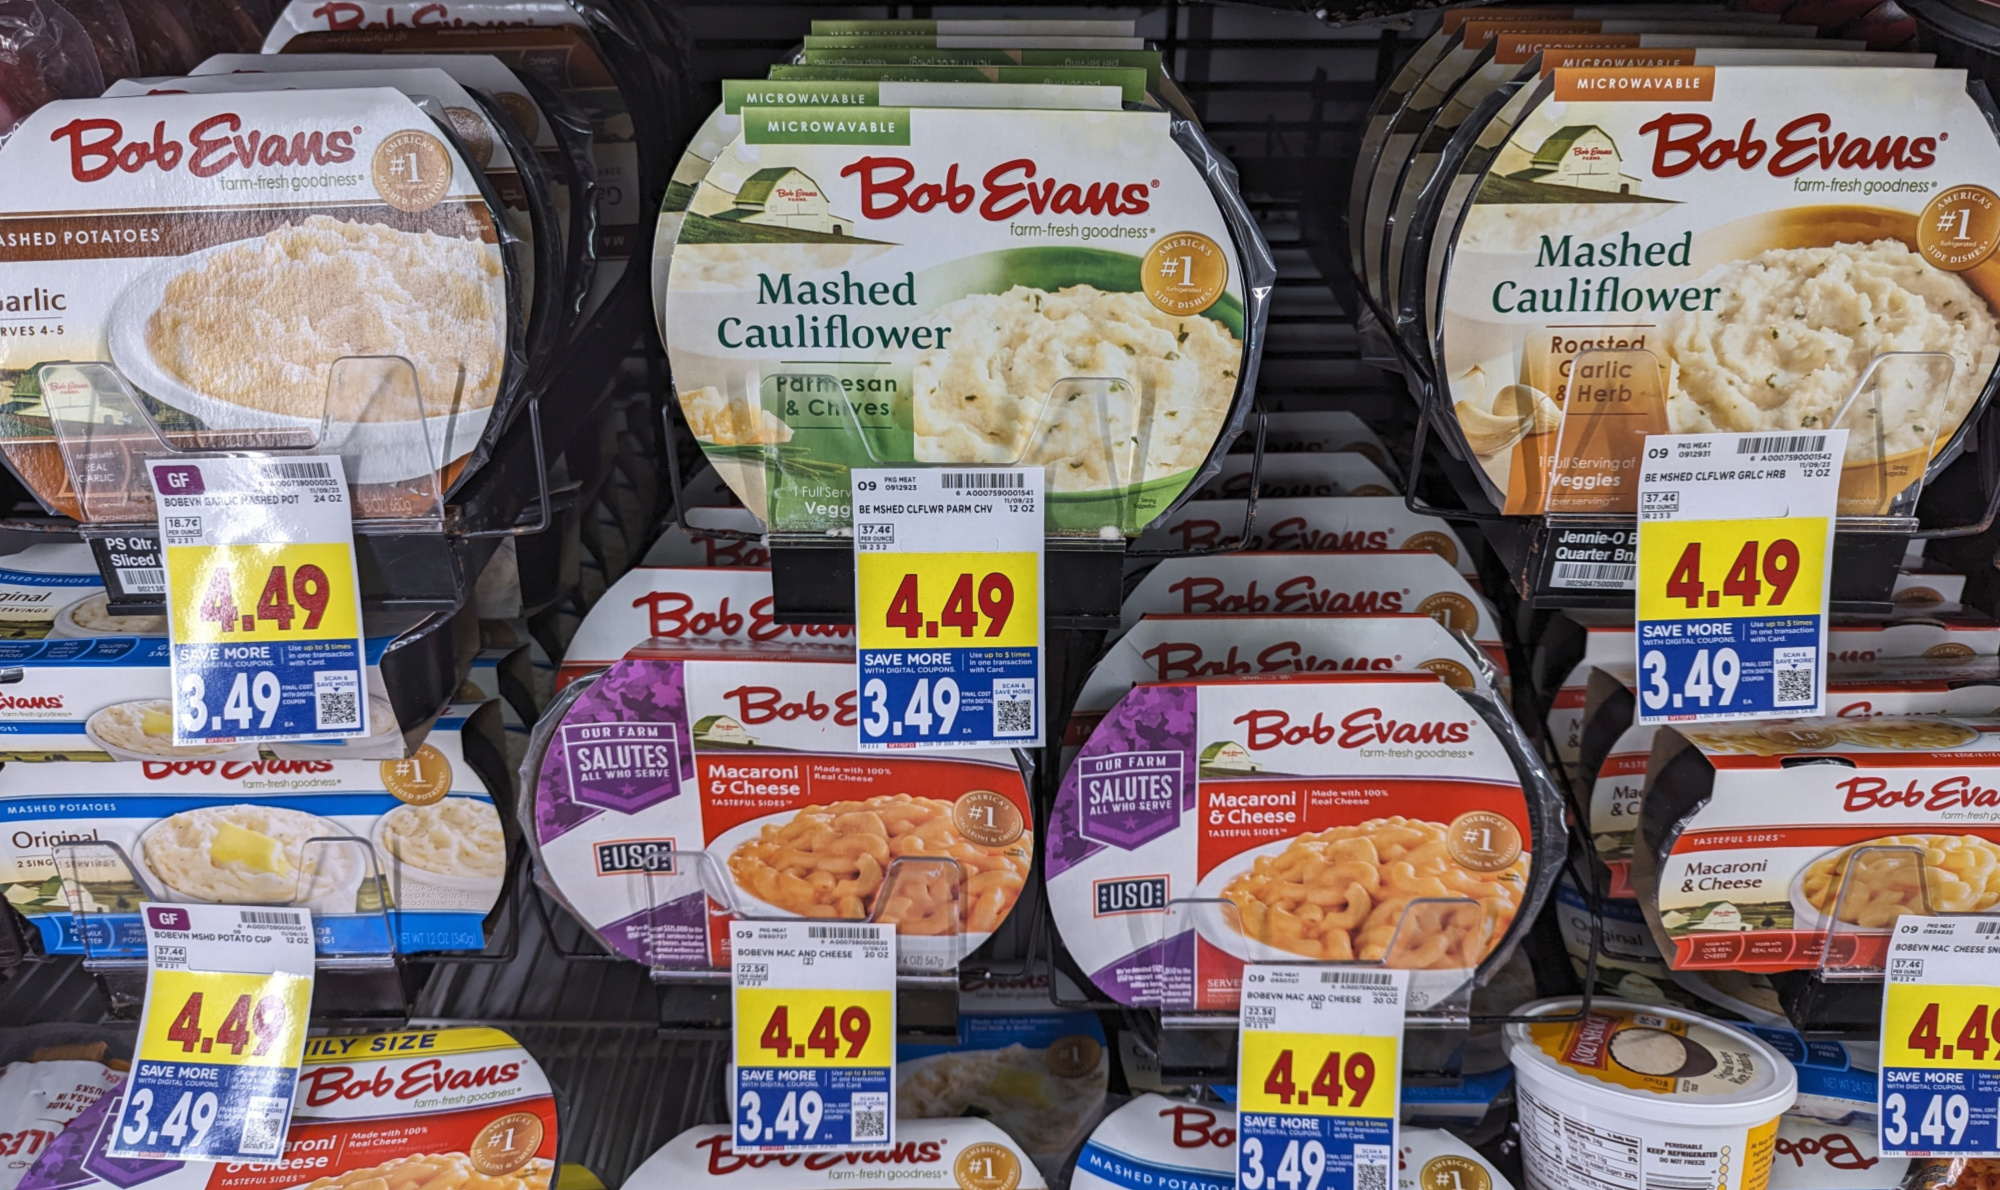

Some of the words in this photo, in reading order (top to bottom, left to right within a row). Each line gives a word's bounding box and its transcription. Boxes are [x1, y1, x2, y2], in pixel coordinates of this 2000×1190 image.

[1576, 77, 1701, 89] MICROWAVABLE
[746, 92, 866, 104] MICROWAVABLE
[767, 120, 895, 134] MICROWAVABLE
[51, 117, 184, 184] Bob
[188, 113, 356, 179] Evans
[1639, 112, 1769, 178] Bob
[1767, 113, 1936, 178] Evans
[389, 153, 424, 183] #1
[220, 174, 291, 192] farm-fresh
[291, 173, 358, 192] goodness
[840, 156, 976, 220] Bob
[979, 158, 1150, 221] Evans
[1794, 177, 1862, 193] farm-fresh
[1863, 177, 1930, 194] goodness
[1937, 191, 1993, 211] AMERICA'S
[1010, 222, 1080, 239] farm-fresh
[1081, 223, 1148, 241] goodness
[1936, 208, 1971, 240] #1
[64, 228, 160, 245] POTATOES
[1158, 239, 1213, 257] AMERICA'S
[1535, 231, 1693, 269] Mashed
[1927, 244, 1948, 262] SIDE
[1950, 244, 1987, 263] DISHES
[1160, 255, 1195, 286] #1
[756, 271, 918, 306] Mashed
[1492, 276, 1721, 314] Cauliflower
[1153, 290, 1174, 308] SIDE
[1177, 290, 1212, 309] DISHES
[717, 314, 952, 350] Cauliflower
[1550, 335, 1646, 354] Roasted
[1558, 360, 1633, 379] Garlic
[776, 375, 898, 393] Parmesan
[1555, 385, 1568, 402] &
[1577, 384, 1633, 403] Herb
[785, 400, 800, 416] &
[1648, 448, 1669, 459] 09
[167, 472, 190, 489] GF
[1548, 472, 1621, 490] Veggies
[1644, 473, 1658, 483] BE
[1659, 472, 1693, 482] MSHED
[1695, 471, 1735, 481] CLFLWR
[1738, 470, 1763, 480] GRLC
[1766, 469, 1786, 479] HRB
[1803, 469, 1813, 478] 12
[1815, 468, 1830, 477] OZ
[857, 481, 877, 491] 09
[164, 496, 202, 507] BOBEVN
[281, 494, 299, 504] POT
[859, 505, 872, 514] BE
[873, 505, 904, 514] MSHED
[907, 505, 944, 514] CLFLWR
[946, 505, 971, 513] PARM
[974, 504, 993, 513] CHV
[1009, 505, 1018, 513] 12
[1021, 504, 1035, 513] OZ
[862, 525, 891, 534] 37.4¢
[1559, 530, 1626, 546] Jennie-O
[105, 537, 127, 551] PS
[129, 537, 158, 551] Qtr.
[110, 554, 157, 568] Sliced
[1555, 547, 1612, 561] Quarter
[1666, 538, 1801, 610] 4.49
[200, 563, 331, 633] 4.49
[1168, 576, 1269, 613] Bob
[1273, 575, 1403, 613] Evans
[886, 571, 1015, 638] 4.49
[632, 591, 743, 637] Bob
[1643, 625, 1682, 638] SAVE
[1687, 623, 1733, 636] MORE
[224, 646, 270, 659] MORE
[864, 653, 902, 666] SAVE
[907, 653, 952, 665] MORE
[917, 666, 957, 674] COUPONS.
[987, 666, 1006, 674] Card.
[1642, 647, 1741, 710] 3.49
[180, 670, 281, 733] 3.49
[723, 686, 829, 725] Bob
[863, 676, 960, 738] 3.49
[1233, 709, 1335, 751] Bob
[1337, 708, 1469, 749] Evans
[578, 744, 669, 772] SALUTES
[1360, 748, 1414, 759] farm-fresh
[1415, 748, 1467, 760] goodness
[708, 764, 799, 779] Macaroni
[1095, 759, 1122, 772] OUR
[1128, 756, 1167, 768] FARM
[711, 781, 727, 795] &
[729, 780, 800, 796] Cheese
[1089, 775, 1173, 804] SALUTES
[1836, 776, 1924, 812] Bob
[1089, 805, 1109, 816] ALL
[1112, 803, 1136, 813] WHO
[1139, 801, 1172, 811] SERVE
[1208, 791, 1296, 808] Macaroni
[7, 805, 57, 815] MASHED
[60, 803, 117, 813] POTATOES
[968, 804, 997, 829] #1
[1209, 810, 1224, 825] &
[1227, 809, 1296, 825] Cheese
[1208, 829, 1251, 838] TASTEFUL
[1253, 828, 1280, 837] SIDES
[1462, 828, 1494, 852] #1
[1693, 835, 1744, 846] TASTEFUL
[1746, 834, 1779, 843] SIDES
[1684, 859, 1768, 877] Macaroni
[1681, 880, 1694, 893] &
[1698, 877, 1762, 891] Cheese
[1109, 881, 1153, 910] USO
[158, 912, 178, 926] GF
[155, 931, 190, 940] BOBEVN
[192, 933, 216, 942] MSHD
[218, 934, 252, 943] POTATO
[254, 935, 272, 944] CUP
[287, 936, 295, 944] 12
[297, 936, 309, 945] OZ
[738, 949, 774, 957] BOBEVN
[798, 950, 816, 958] AND
[819, 950, 853, 959] CHEESE
[167, 992, 286, 1057] 4.49
[760, 1005, 872, 1058] 4.49
[370, 1033, 438, 1052] SIZE
[140, 1064, 175, 1079] SAVE
[178, 1067, 219, 1080] MORE
[1264, 1049, 1376, 1108] 4.49
[300, 1066, 394, 1107] Bob
[395, 1059, 520, 1100] Evans
[122, 1087, 219, 1147] 3.49
[739, 1090, 824, 1142] 3.49
[1885, 1092, 1970, 1146] 3.49
[1646, 1147, 1666, 1156] KEEP
[1667, 1149, 1718, 1158] REFRIGERATED
[1664, 1141, 1703, 1150] PERISHABLE
[1090, 1154, 1153, 1184] MASHED
[1241, 1136, 1326, 1190] 3.49
[221, 1177, 267, 1187] TASTEFUL
[269, 1175, 297, 1184] SIDES
